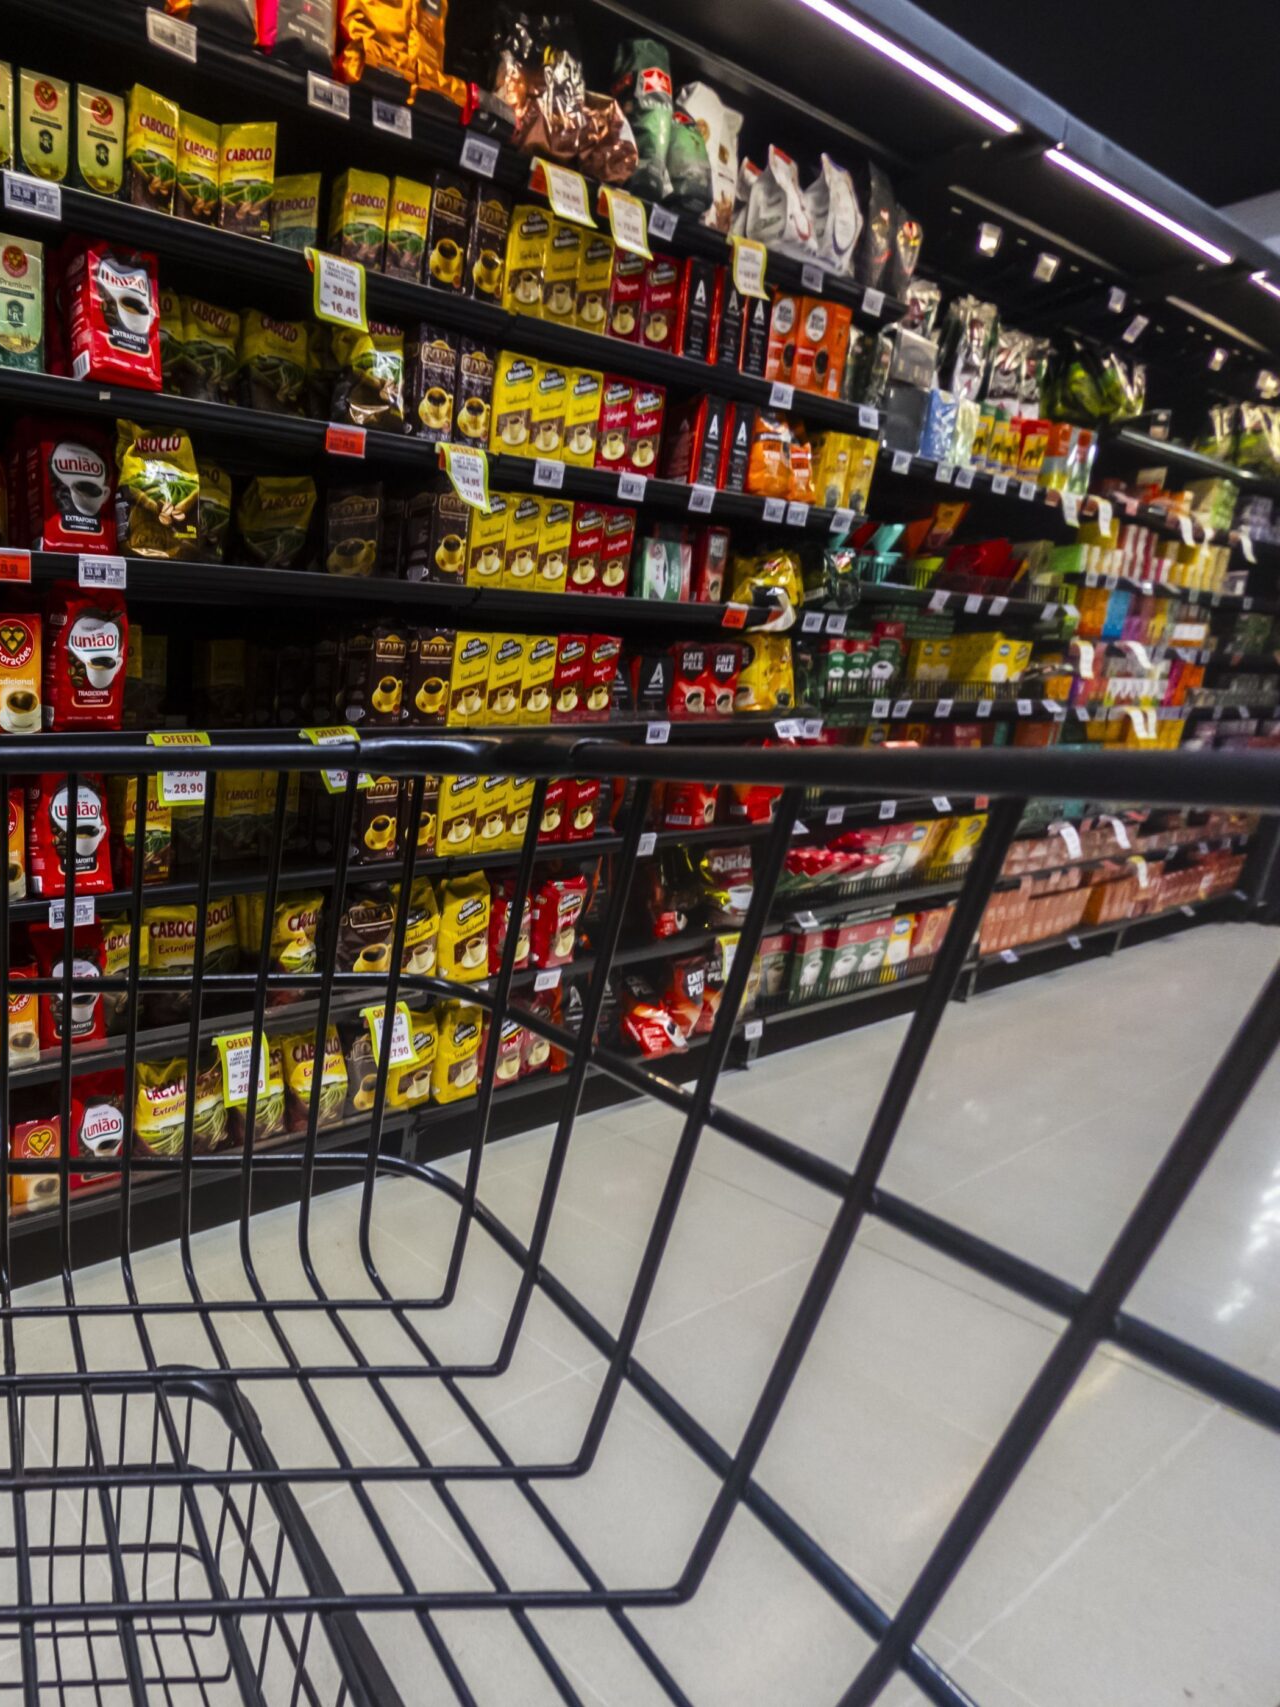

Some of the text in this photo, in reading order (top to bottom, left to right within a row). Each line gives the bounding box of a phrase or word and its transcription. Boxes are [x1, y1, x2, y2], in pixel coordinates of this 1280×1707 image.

[140, 112, 176, 140] CABOCLO
[183, 138, 218, 163] CABOCLO
[225, 147, 272, 161] CABOCLO
[271, 196, 316, 212] CABOCLO
[351, 192, 385, 208] CABOCLO
[395, 201, 427, 218] CABOCLO
[0, 277, 32, 291] Premium
[331, 302, 359, 319] 16,45
[134, 436, 181, 453] ABOCLO
[57, 458, 101, 474] união
[73, 636, 114, 648] união
[377, 640, 405, 656] FORT
[423, 642, 452, 656] FORT
[161, 734, 201, 745] OFERTA
[174, 783, 203, 794] 28,90
[58, 803, 98, 816] uião
[150, 921, 197, 938] CABOCL
[86, 1118, 119, 1137] união
